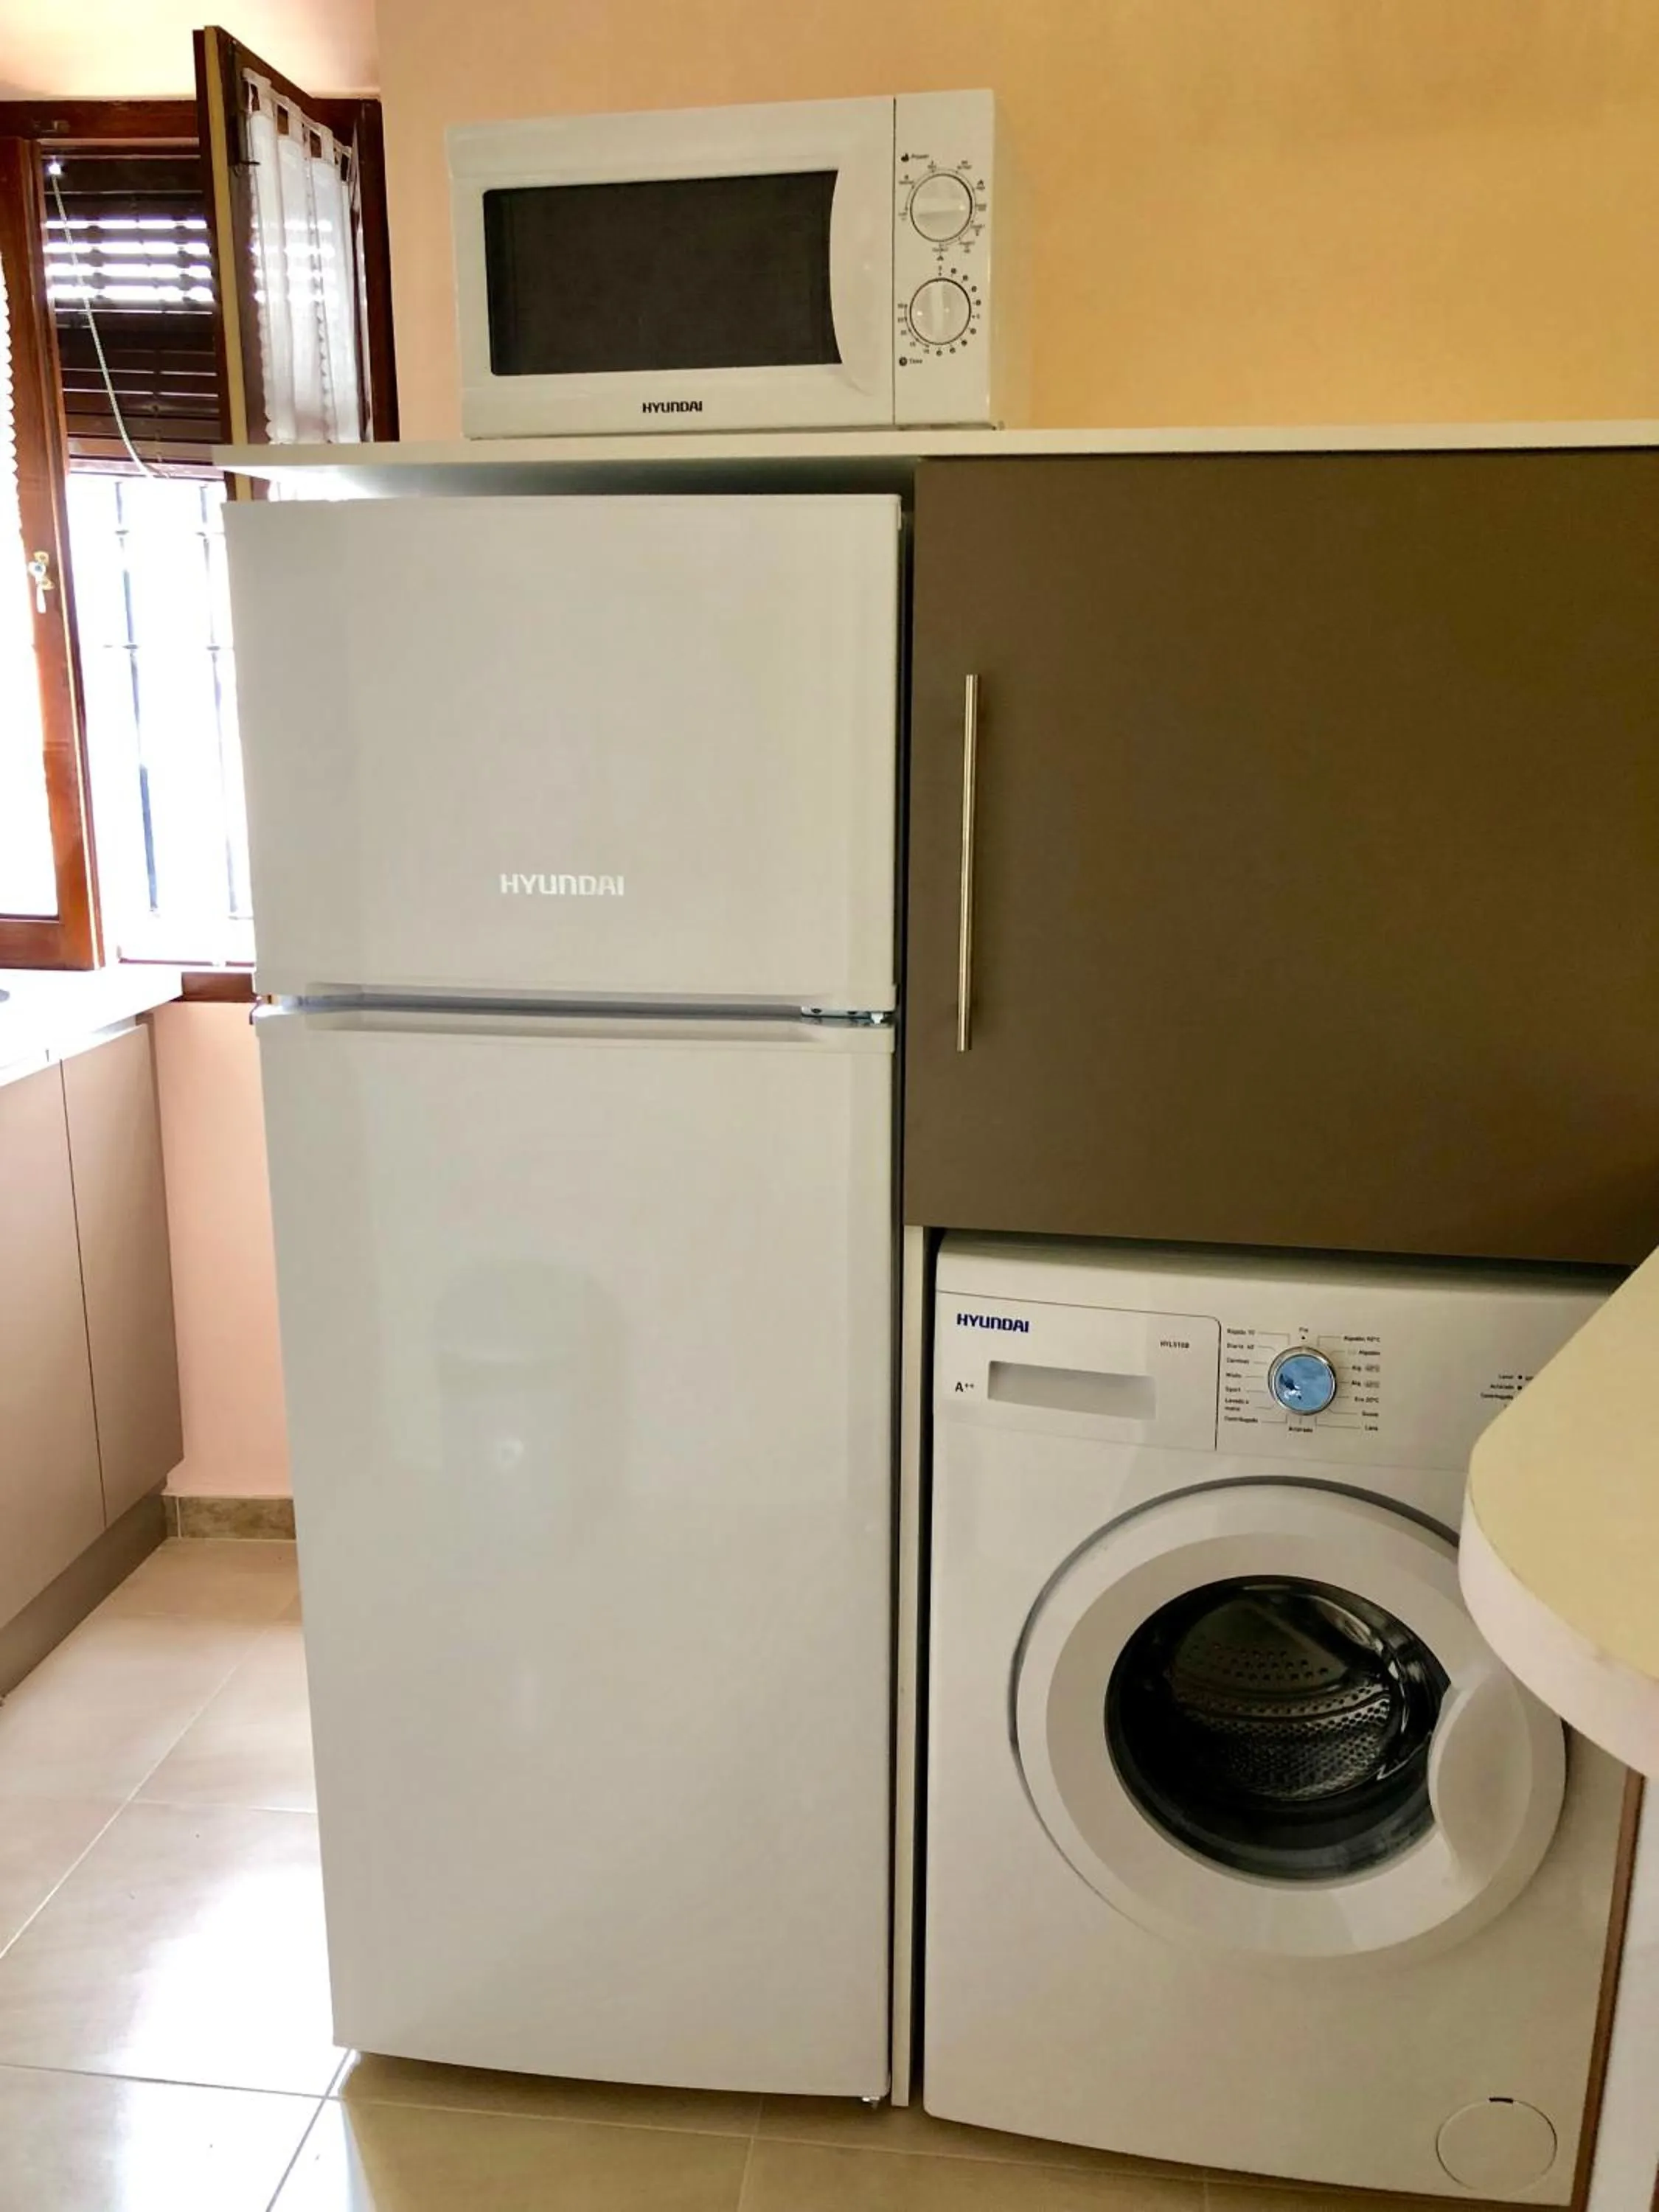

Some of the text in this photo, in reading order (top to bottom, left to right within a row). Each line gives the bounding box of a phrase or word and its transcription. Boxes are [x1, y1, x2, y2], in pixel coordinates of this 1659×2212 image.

[642, 400, 703, 414] HYUNDAI
[500, 873, 625, 897] HYUNDAI
[956, 1313, 1030, 1333] HYUNDAI
